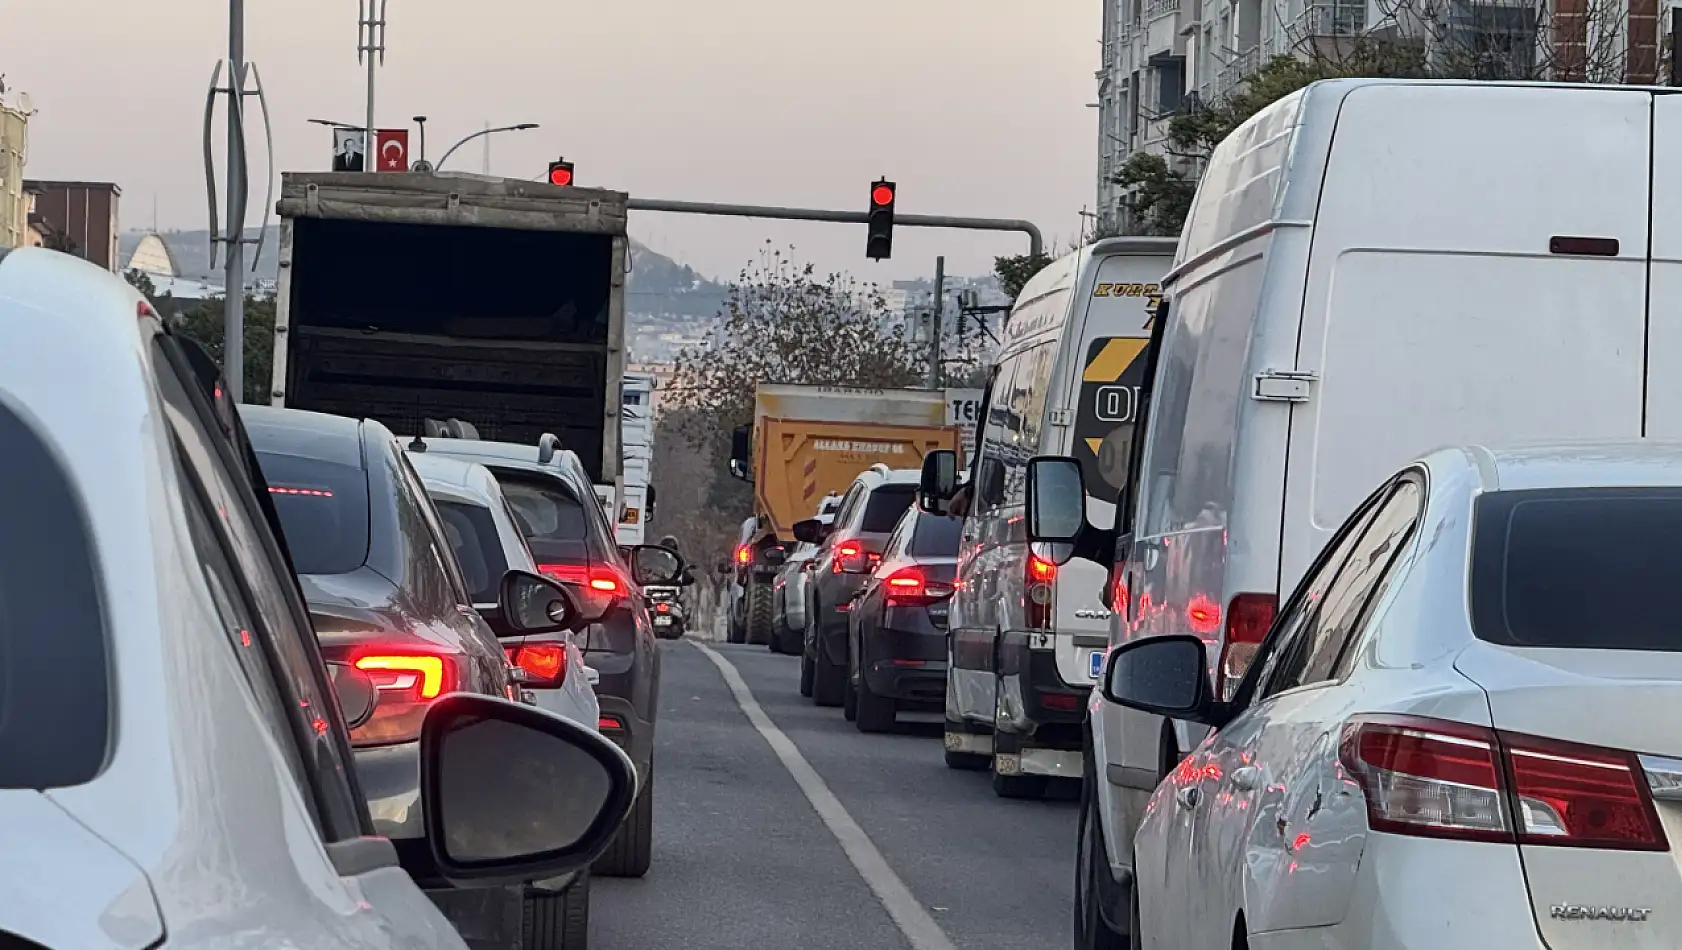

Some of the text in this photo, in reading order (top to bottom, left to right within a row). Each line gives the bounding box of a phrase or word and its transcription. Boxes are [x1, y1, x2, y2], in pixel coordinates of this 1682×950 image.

[1094, 283, 1159, 297] KURT
[1095, 385, 1141, 422] O
[1550, 904, 1652, 922] RENAULT
